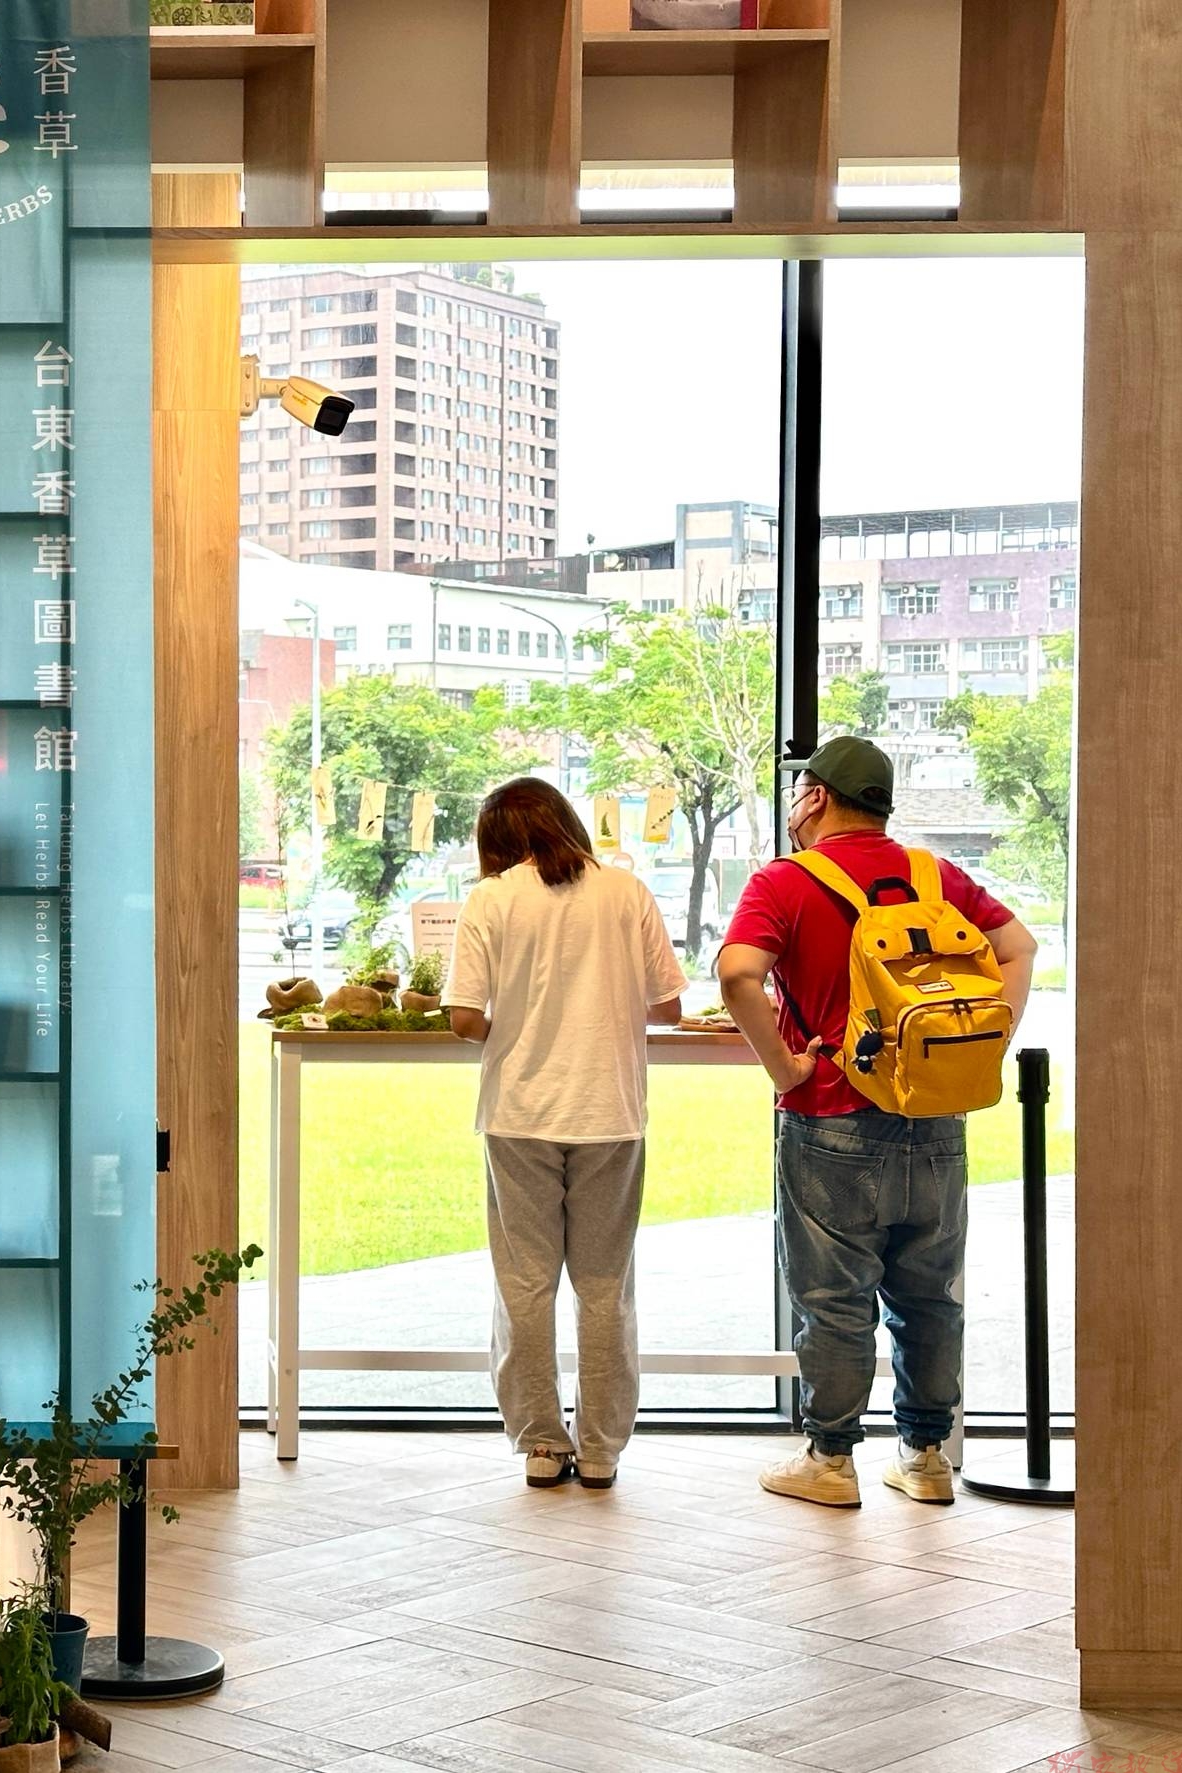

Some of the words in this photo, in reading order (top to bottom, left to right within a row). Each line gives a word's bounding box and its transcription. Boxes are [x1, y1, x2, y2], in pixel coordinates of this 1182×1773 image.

[33, 46, 78, 159] 香草
[31, 340, 78, 773] 台東香草圖書館
[35, 803, 50, 830] Let
[35, 840, 50, 891] Herbs
[35, 900, 51, 944] Read
[60, 882, 76, 935] Herbs
[35, 952, 51, 994] Your
[36, 1003, 53, 1037] Life
